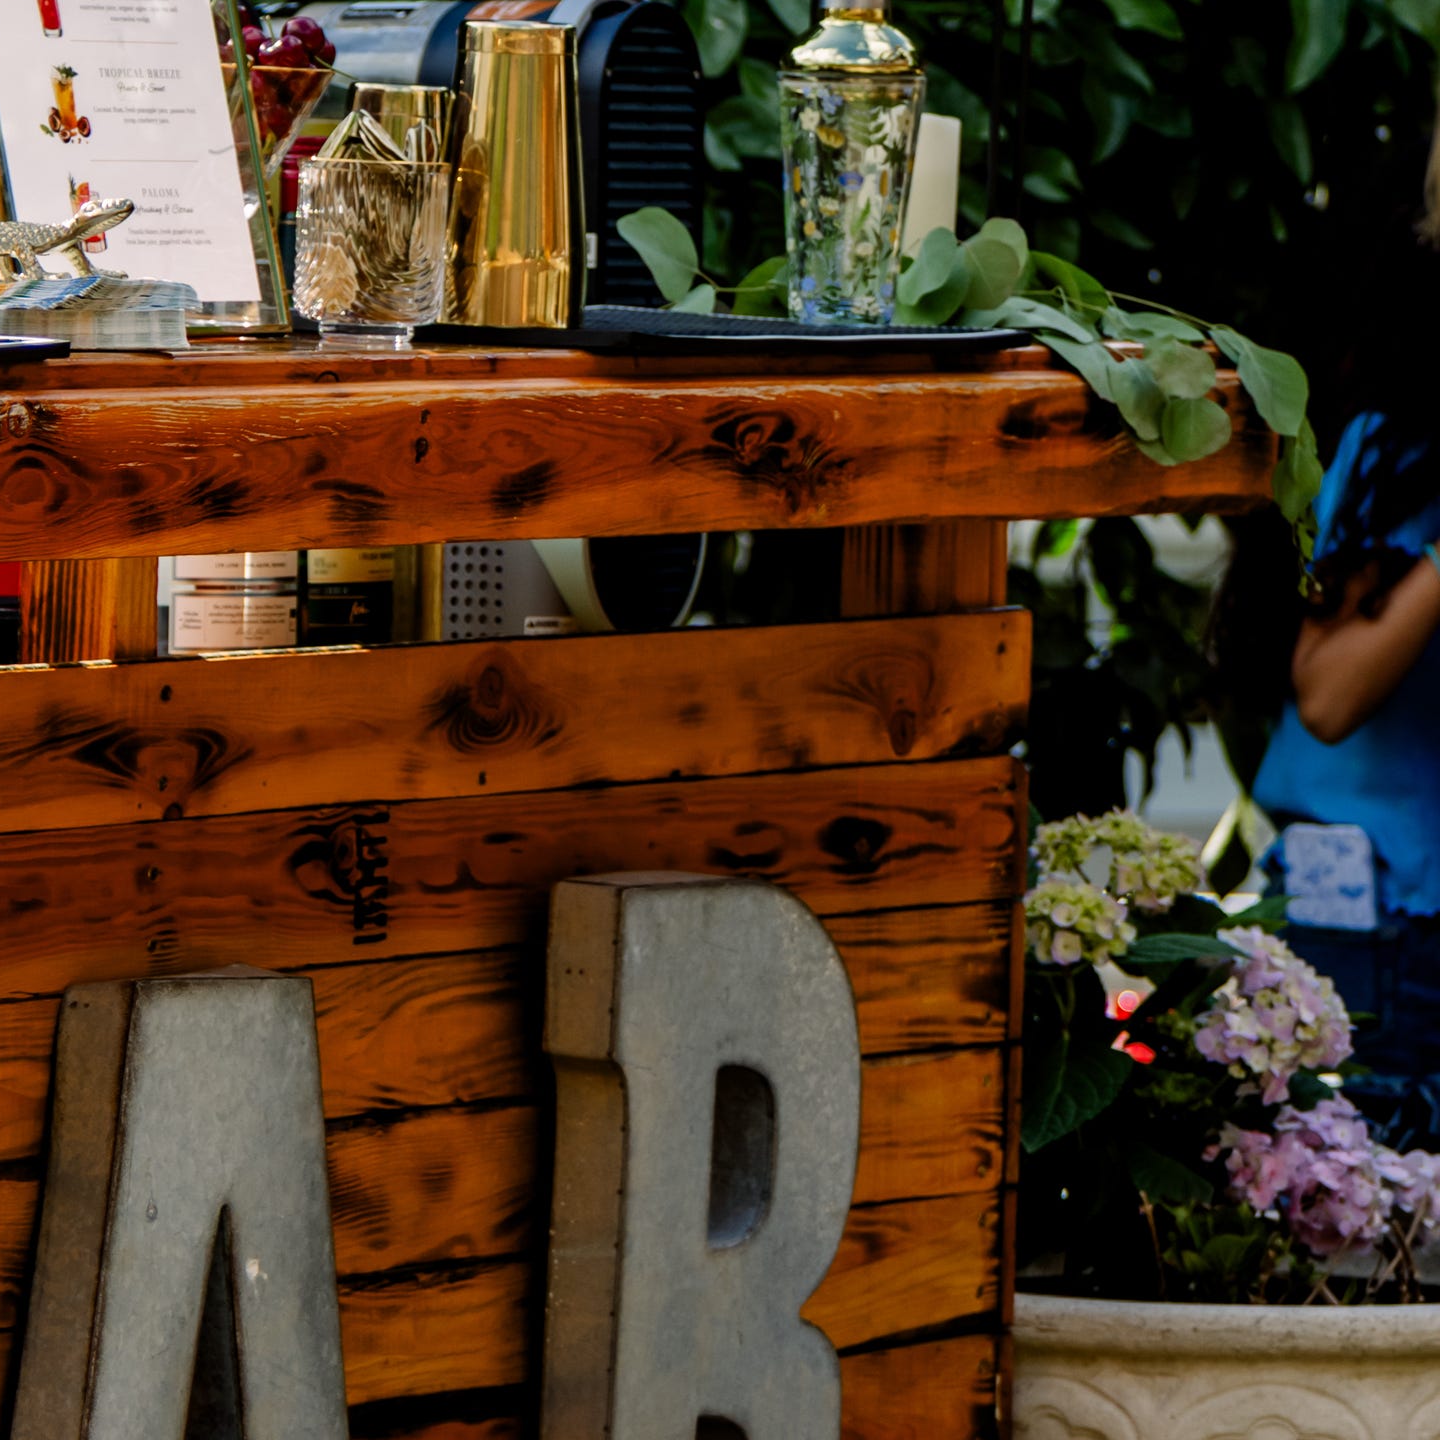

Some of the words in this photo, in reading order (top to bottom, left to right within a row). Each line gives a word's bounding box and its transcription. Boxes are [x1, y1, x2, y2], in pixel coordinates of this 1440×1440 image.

[99, 67, 143, 78] TROPICAL
[147, 68, 182, 79] BREEZE
[141, 187, 180, 198] PALOMA
